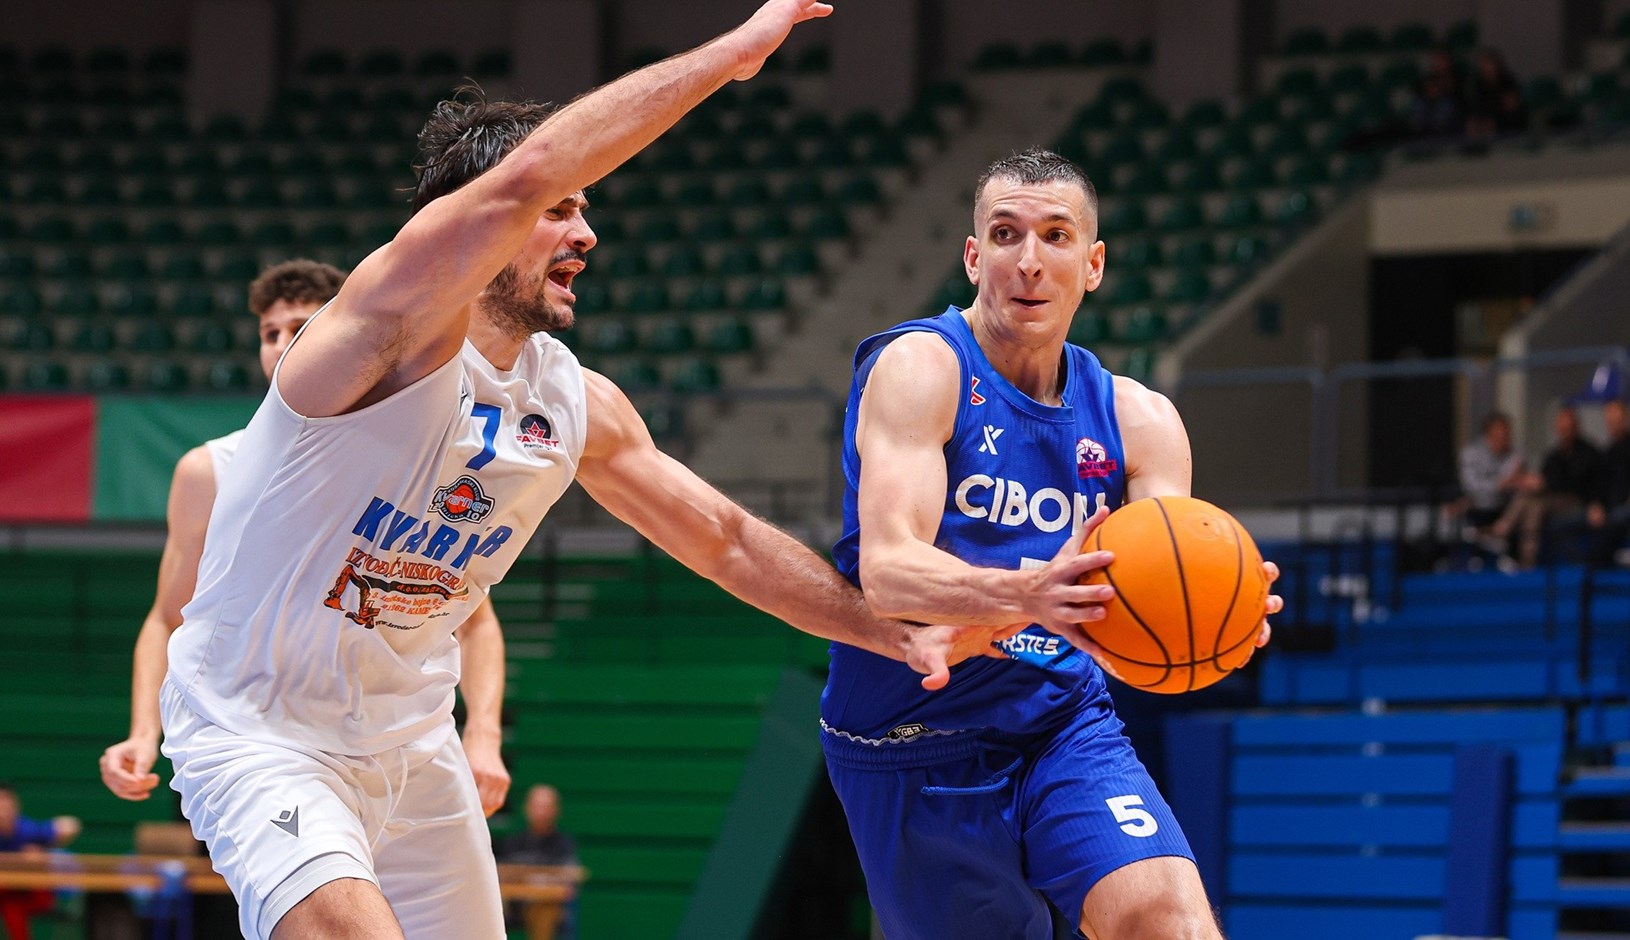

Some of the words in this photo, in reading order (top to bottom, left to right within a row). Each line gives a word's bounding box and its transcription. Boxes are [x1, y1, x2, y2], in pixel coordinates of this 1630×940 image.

[465, 402, 502, 471] 7
[434, 490, 490, 514] Kvarner
[466, 510, 480, 520] 10
[955, 474, 1106, 536] CIBON
[1105, 794, 1159, 838] 5
